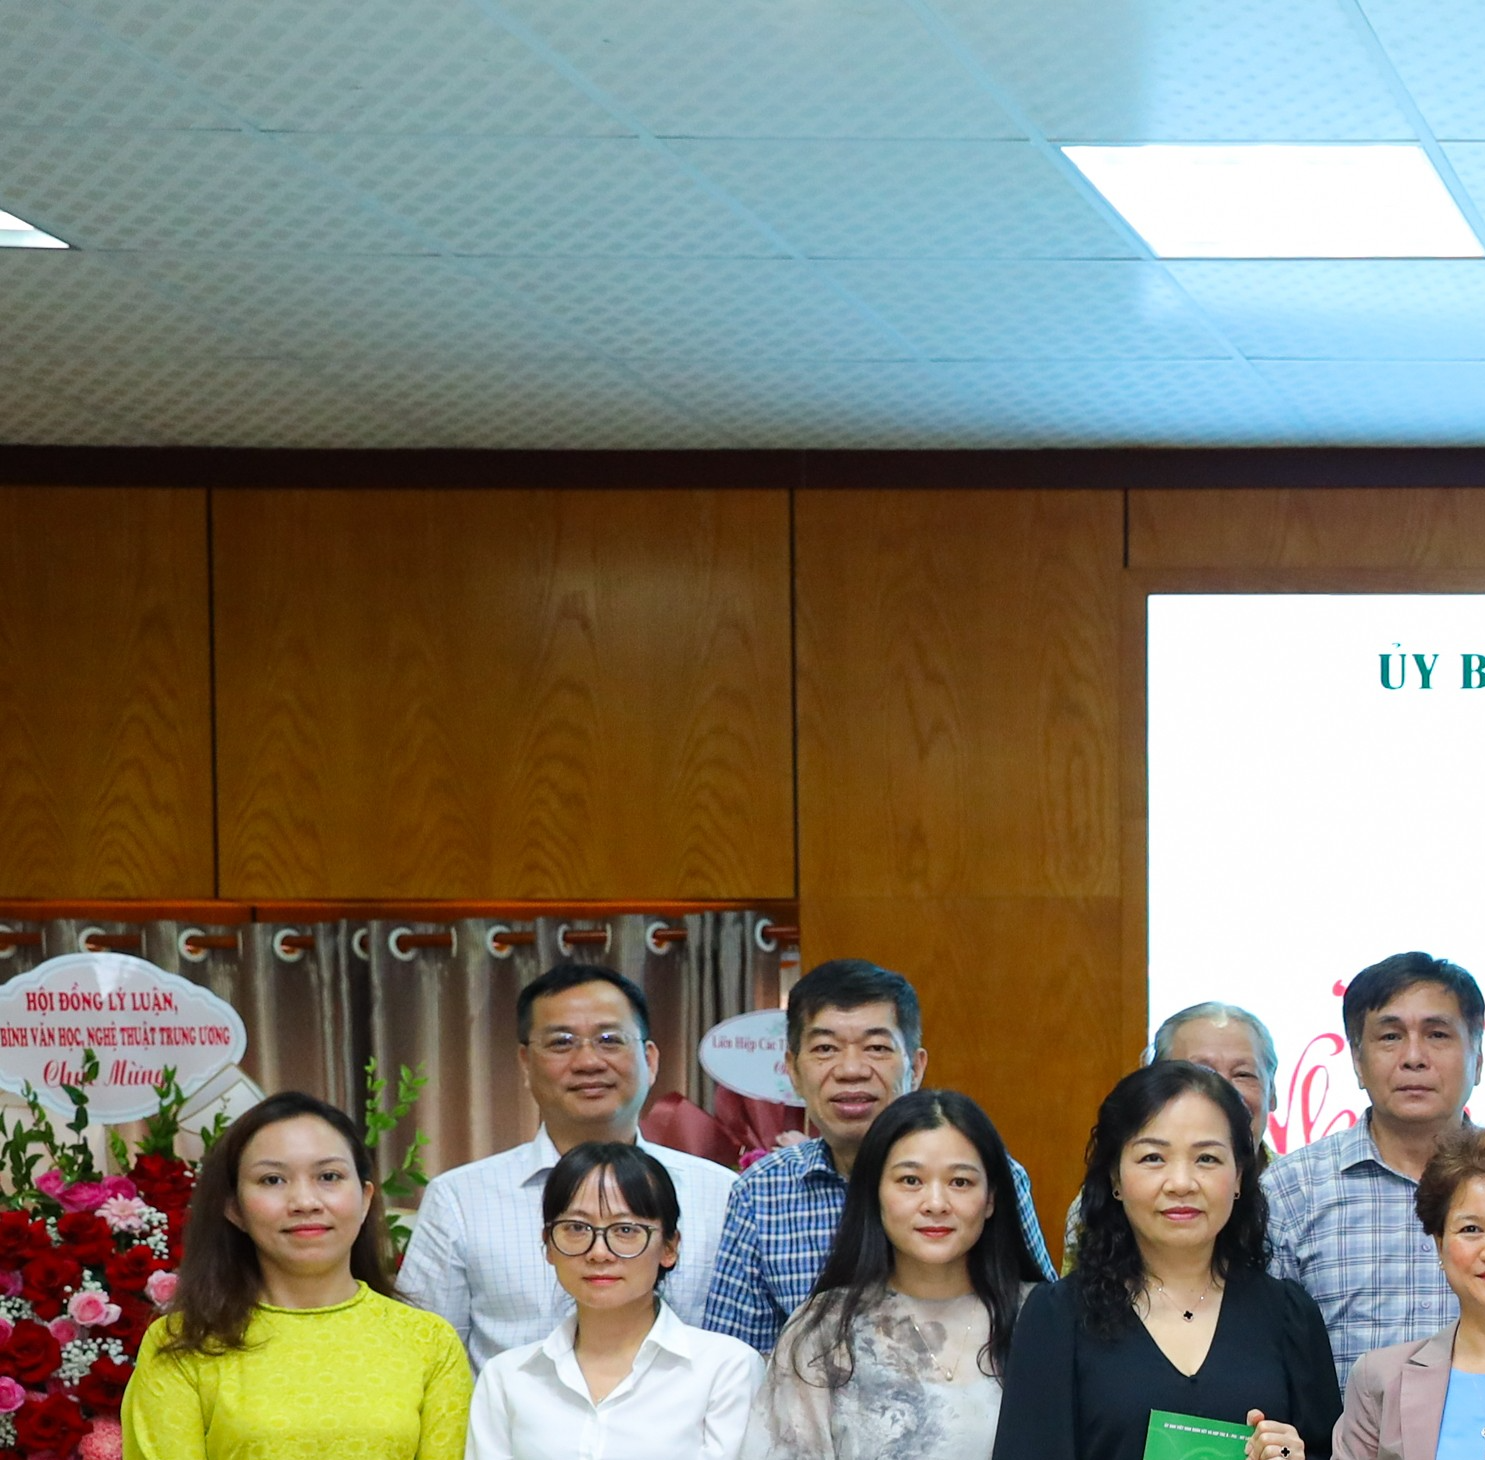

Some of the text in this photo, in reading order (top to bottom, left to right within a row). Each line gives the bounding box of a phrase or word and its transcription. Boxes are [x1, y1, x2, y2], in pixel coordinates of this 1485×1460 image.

[1378, 642, 1440, 691] ỦY
[26, 982, 179, 1016] HỘI ĐỒNG LÝ LUẬN,
[0, 1021, 231, 1052] BÌNH VĂN HỌC, NGHỆ THUẬT TRUNG ƯƠNG
